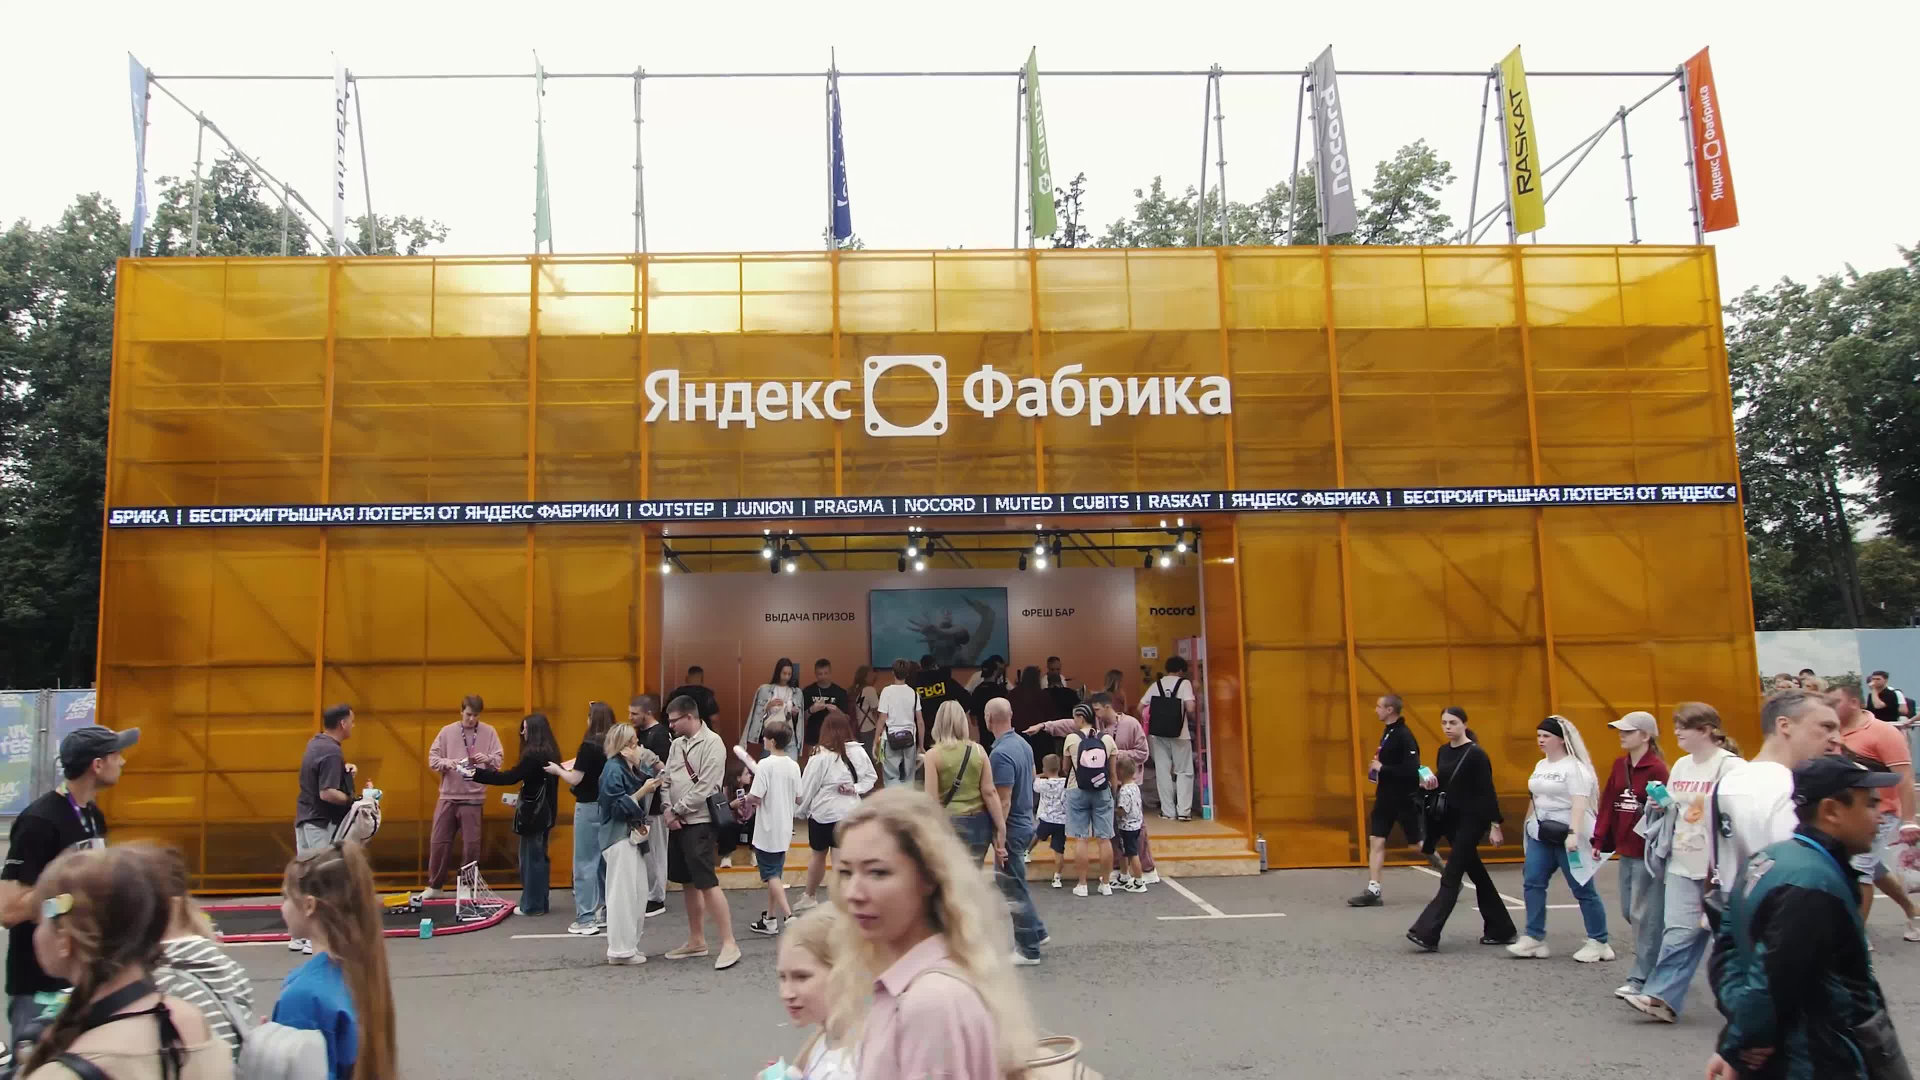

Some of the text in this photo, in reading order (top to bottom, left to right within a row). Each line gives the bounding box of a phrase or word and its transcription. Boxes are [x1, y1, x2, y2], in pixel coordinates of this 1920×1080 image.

[1321, 83, 1349, 196] nocord
[1509, 89, 1534, 195] RASKAT
[1700, 85, 1724, 201] Яндекс Фабрика
[643, 362, 1232, 429] Яндекс Фабрика
[109, 509, 170, 524] БРИКА
[189, 507, 354, 524] БЕСПРОИГРЫШНАЯ
[357, 506, 435, 521] ЛОТЕРЕЯ
[437, 506, 461, 520] ОТ
[464, 504, 534, 522] ЯНДЕКС
[537, 503, 619, 519] ФАБРИКИ
[638, 502, 715, 517] OUTSTEP
[734, 500, 794, 516] JUNION
[814, 499, 885, 514] PRAGMA
[904, 497, 976, 513] NOCORD
[995, 496, 1054, 511] MUTED
[1072, 495, 1130, 510] CUBITS
[1148, 493, 1212, 509] RASKAT
[1231, 492, 1299, 509] ЯНДЕКС
[1301, 491, 1380, 506] ФАБРИКА
[1403, 488, 1561, 504] БЕСПРОИГРЫШНАЯ
[1563, 486, 1635, 501] ЛОТЕРЕЯ
[1636, 486, 1658, 500] ОТ
[1661, 486, 1725, 502] ЯНДЕКС
[765, 612, 855, 623] ВЫДАЧА ПРИЗОВ
[1022, 608, 1075, 617] ФРЕШ БАР
[1149, 605, 1196, 616] nocord
